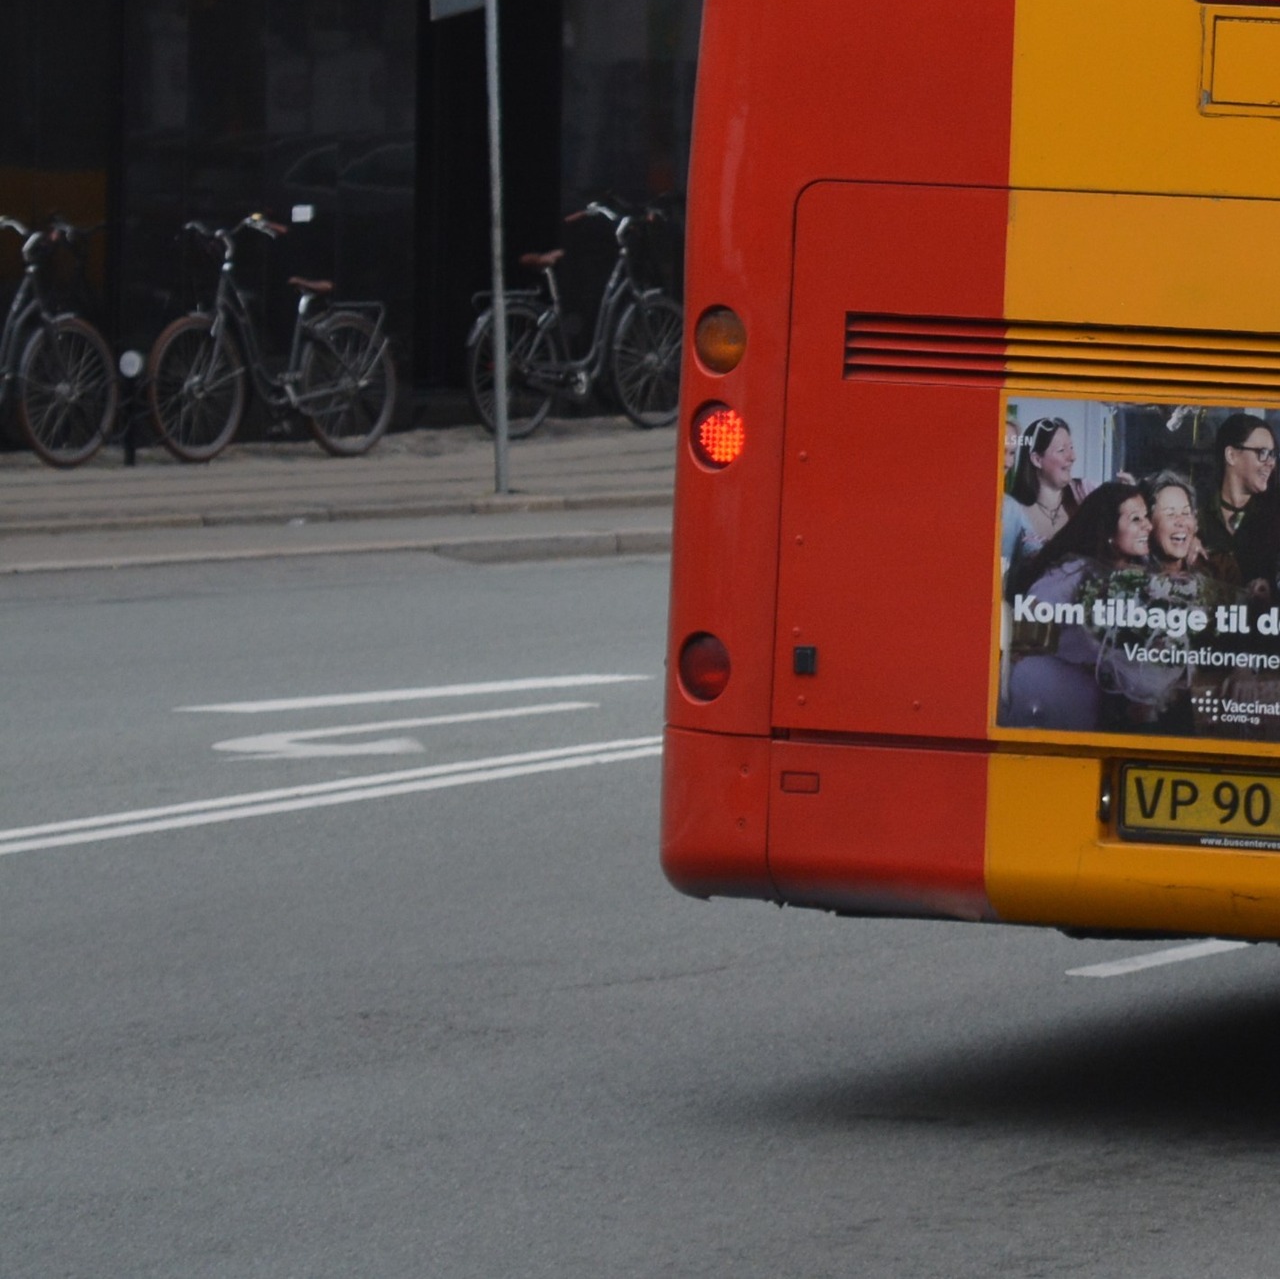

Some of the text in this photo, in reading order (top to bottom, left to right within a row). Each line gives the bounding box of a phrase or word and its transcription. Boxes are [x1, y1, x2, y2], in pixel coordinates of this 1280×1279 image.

[1014, 594, 1085, 625] Kom
[1092, 598, 1208, 638] tilbage
[1215, 605, 1250, 634] til
[1123, 642, 1280, 670] Vaccinationerne
[1221, 714, 1260, 725] COVID-19
[1134, 777, 1198, 821] VP
